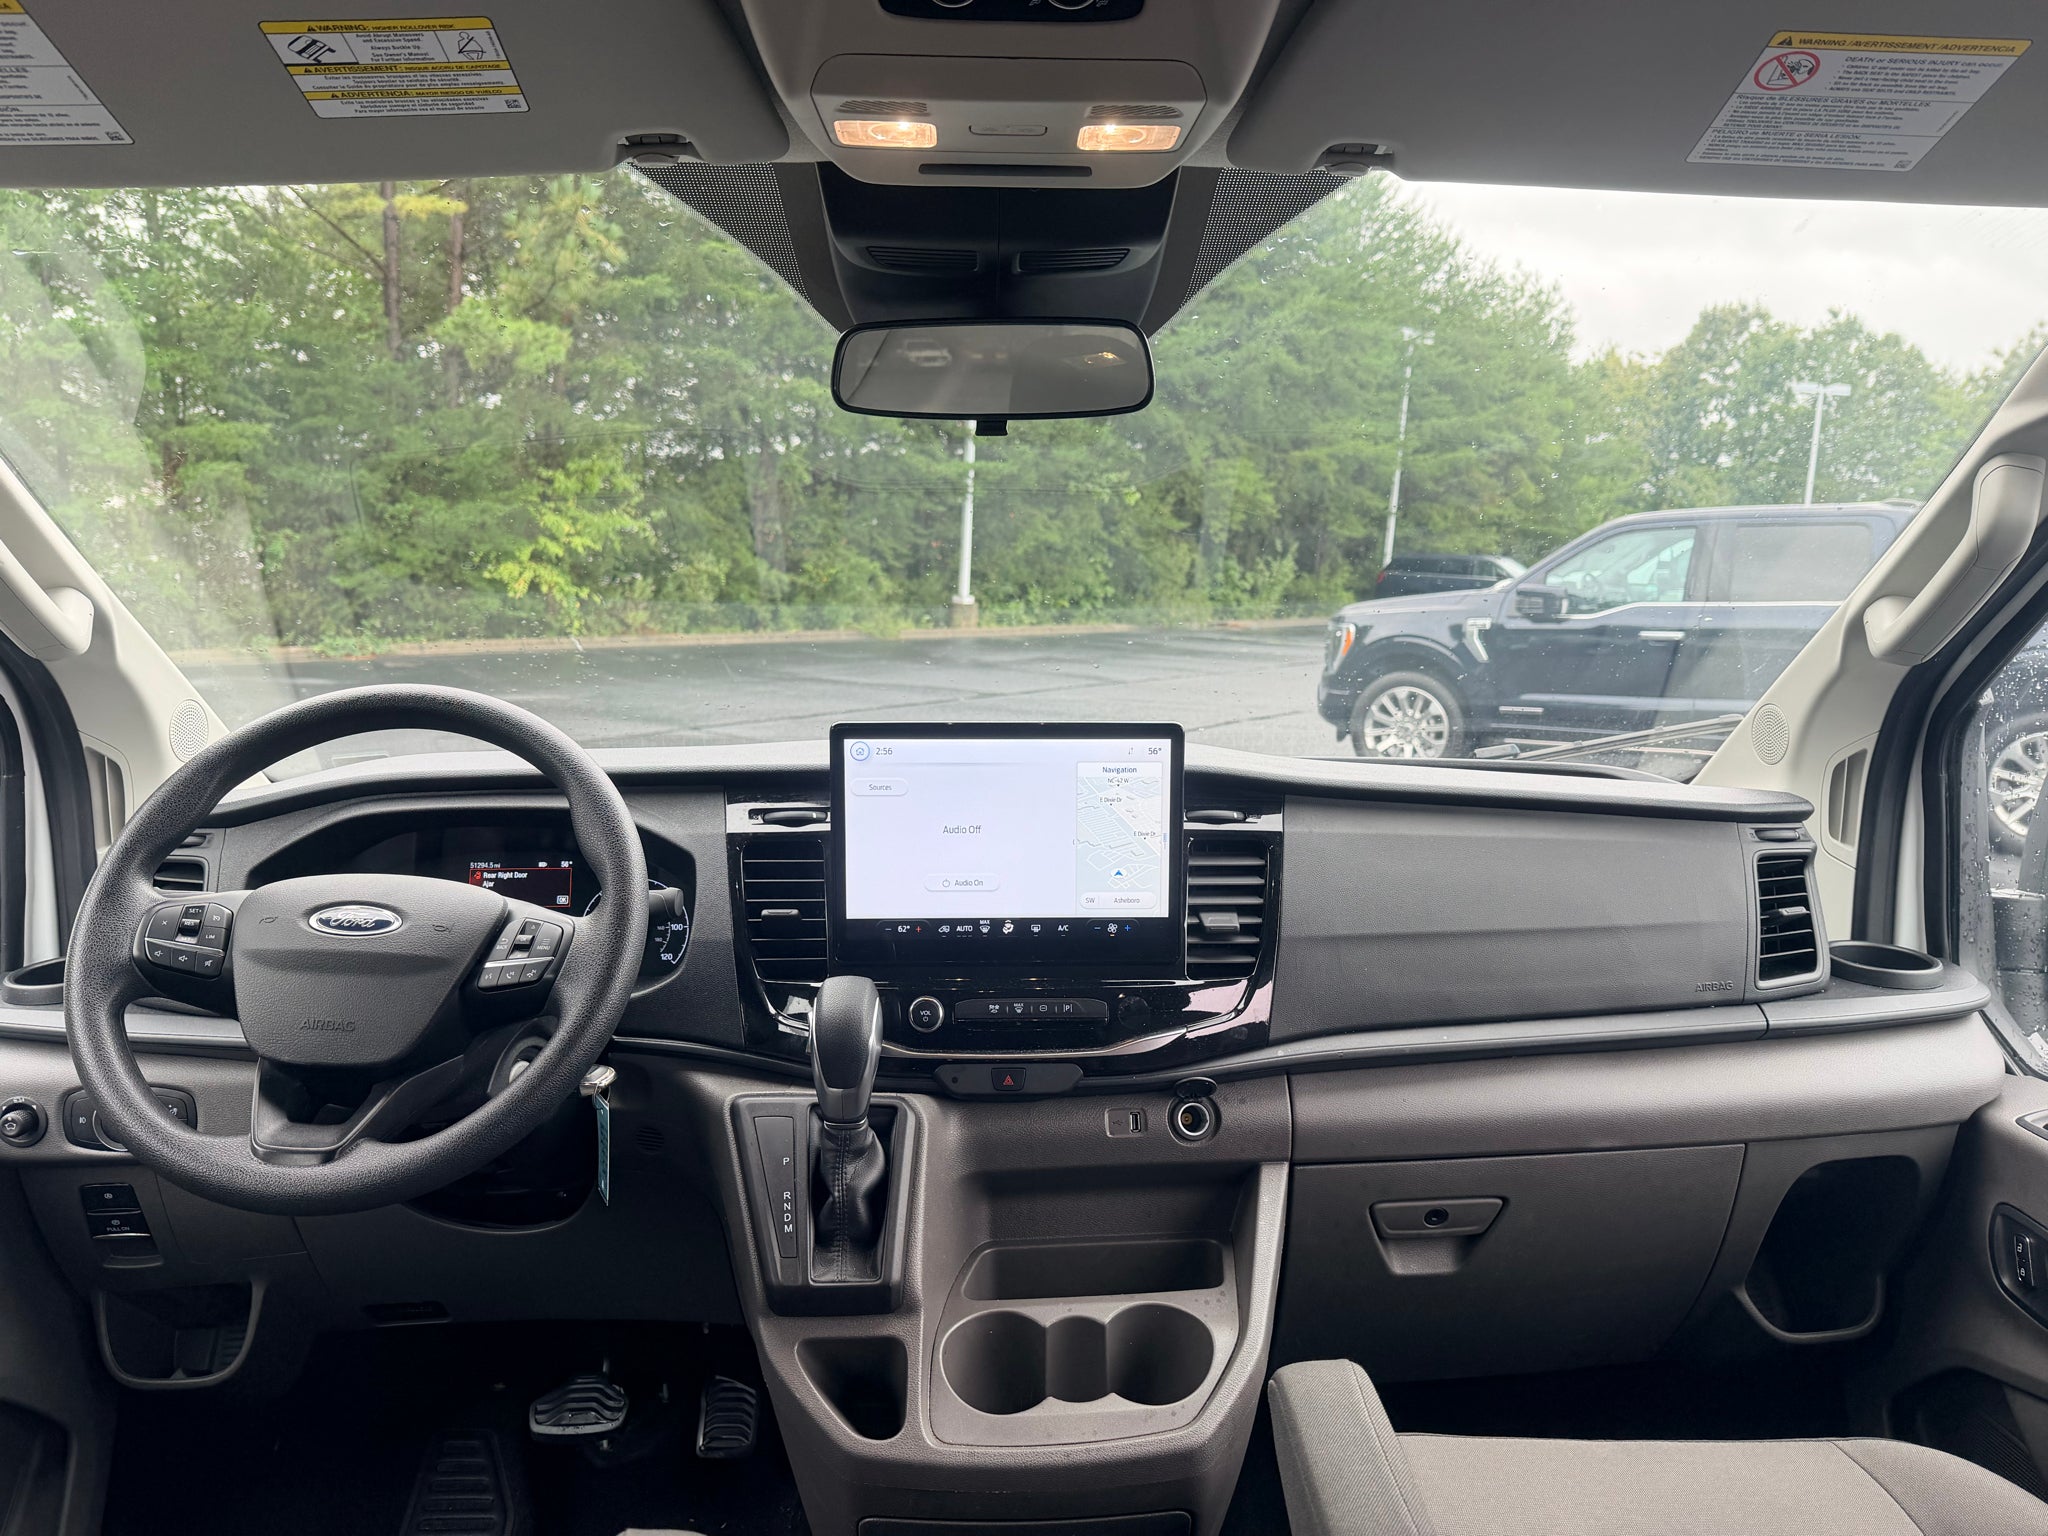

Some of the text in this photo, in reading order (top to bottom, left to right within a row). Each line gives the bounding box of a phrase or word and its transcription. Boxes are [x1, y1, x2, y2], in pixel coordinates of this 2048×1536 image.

[876, 747, 893, 755] 2:56
[1148, 747, 1162, 755] 56°
[1102, 766, 1137, 774] Navigation
[942, 825, 982, 834] Audio Off
[497, 871, 513, 880] Right
[514, 871, 528, 879] Door
[954, 879, 984, 887] Audio On
[329, 912, 376, 929] Ford
[897, 925, 910, 933] 62°
[1057, 924, 1069, 932] A/C
[1695, 980, 1734, 992] AIRBAG
[300, 1018, 356, 1031] AIRBAG
[783, 1157, 790, 1165] P
[783, 1191, 791, 1200] R
[783, 1202, 791, 1210] N
[784, 1213, 792, 1222] D
[784, 1224, 793, 1233] M
